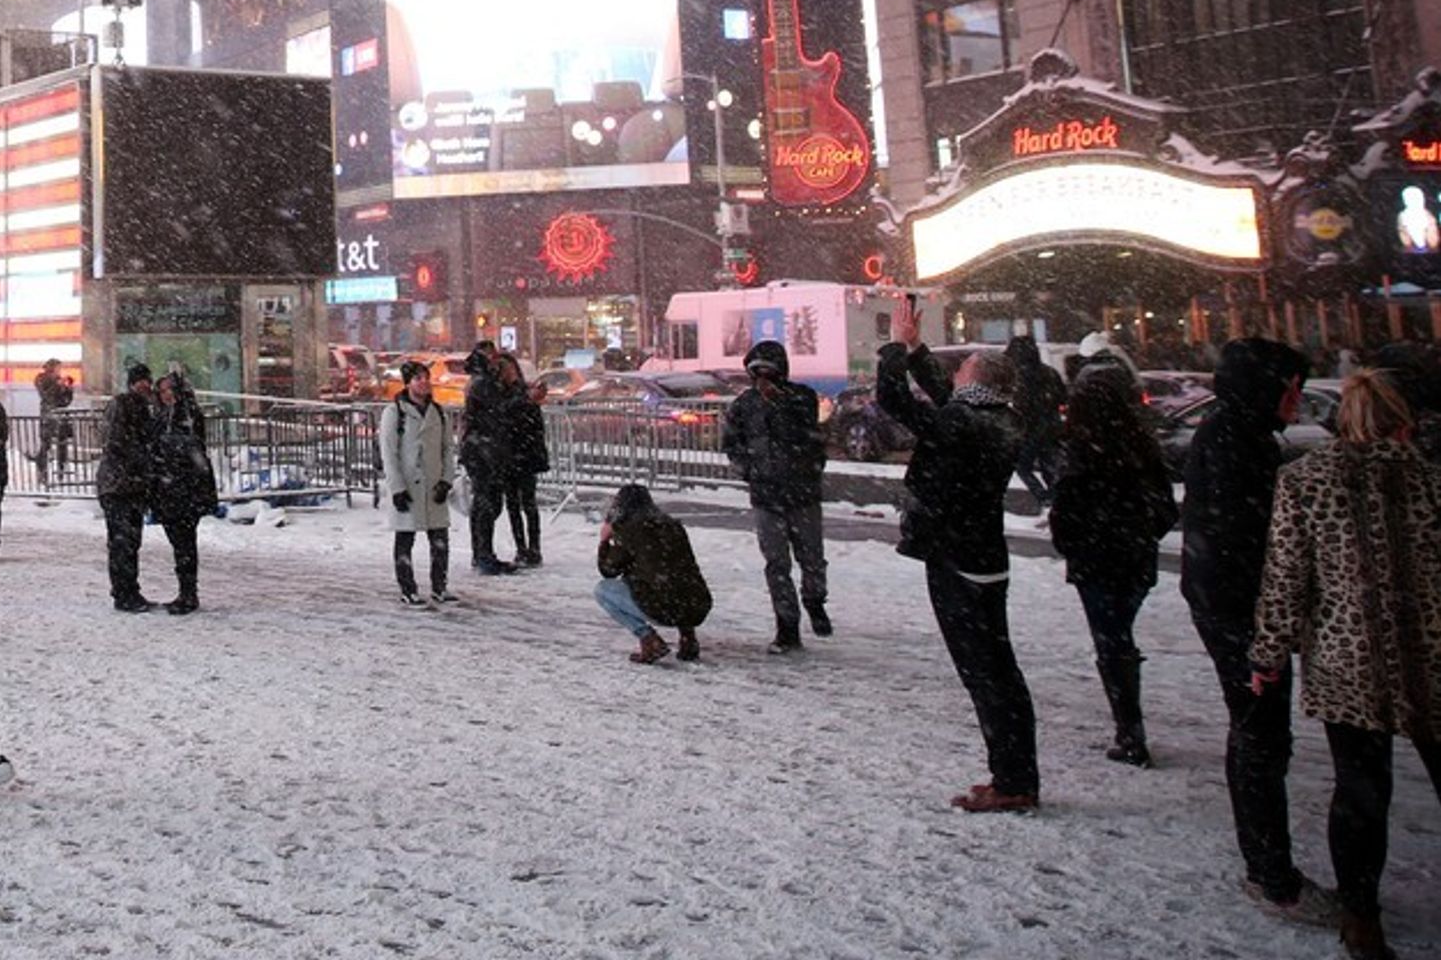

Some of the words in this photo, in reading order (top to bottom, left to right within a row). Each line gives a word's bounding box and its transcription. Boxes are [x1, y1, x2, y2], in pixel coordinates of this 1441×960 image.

[1013, 123, 1065, 157] Hard
[1066, 116, 1121, 152] Rock
[775, 145, 816, 167] Hard
[821, 143, 864, 167] Rock
